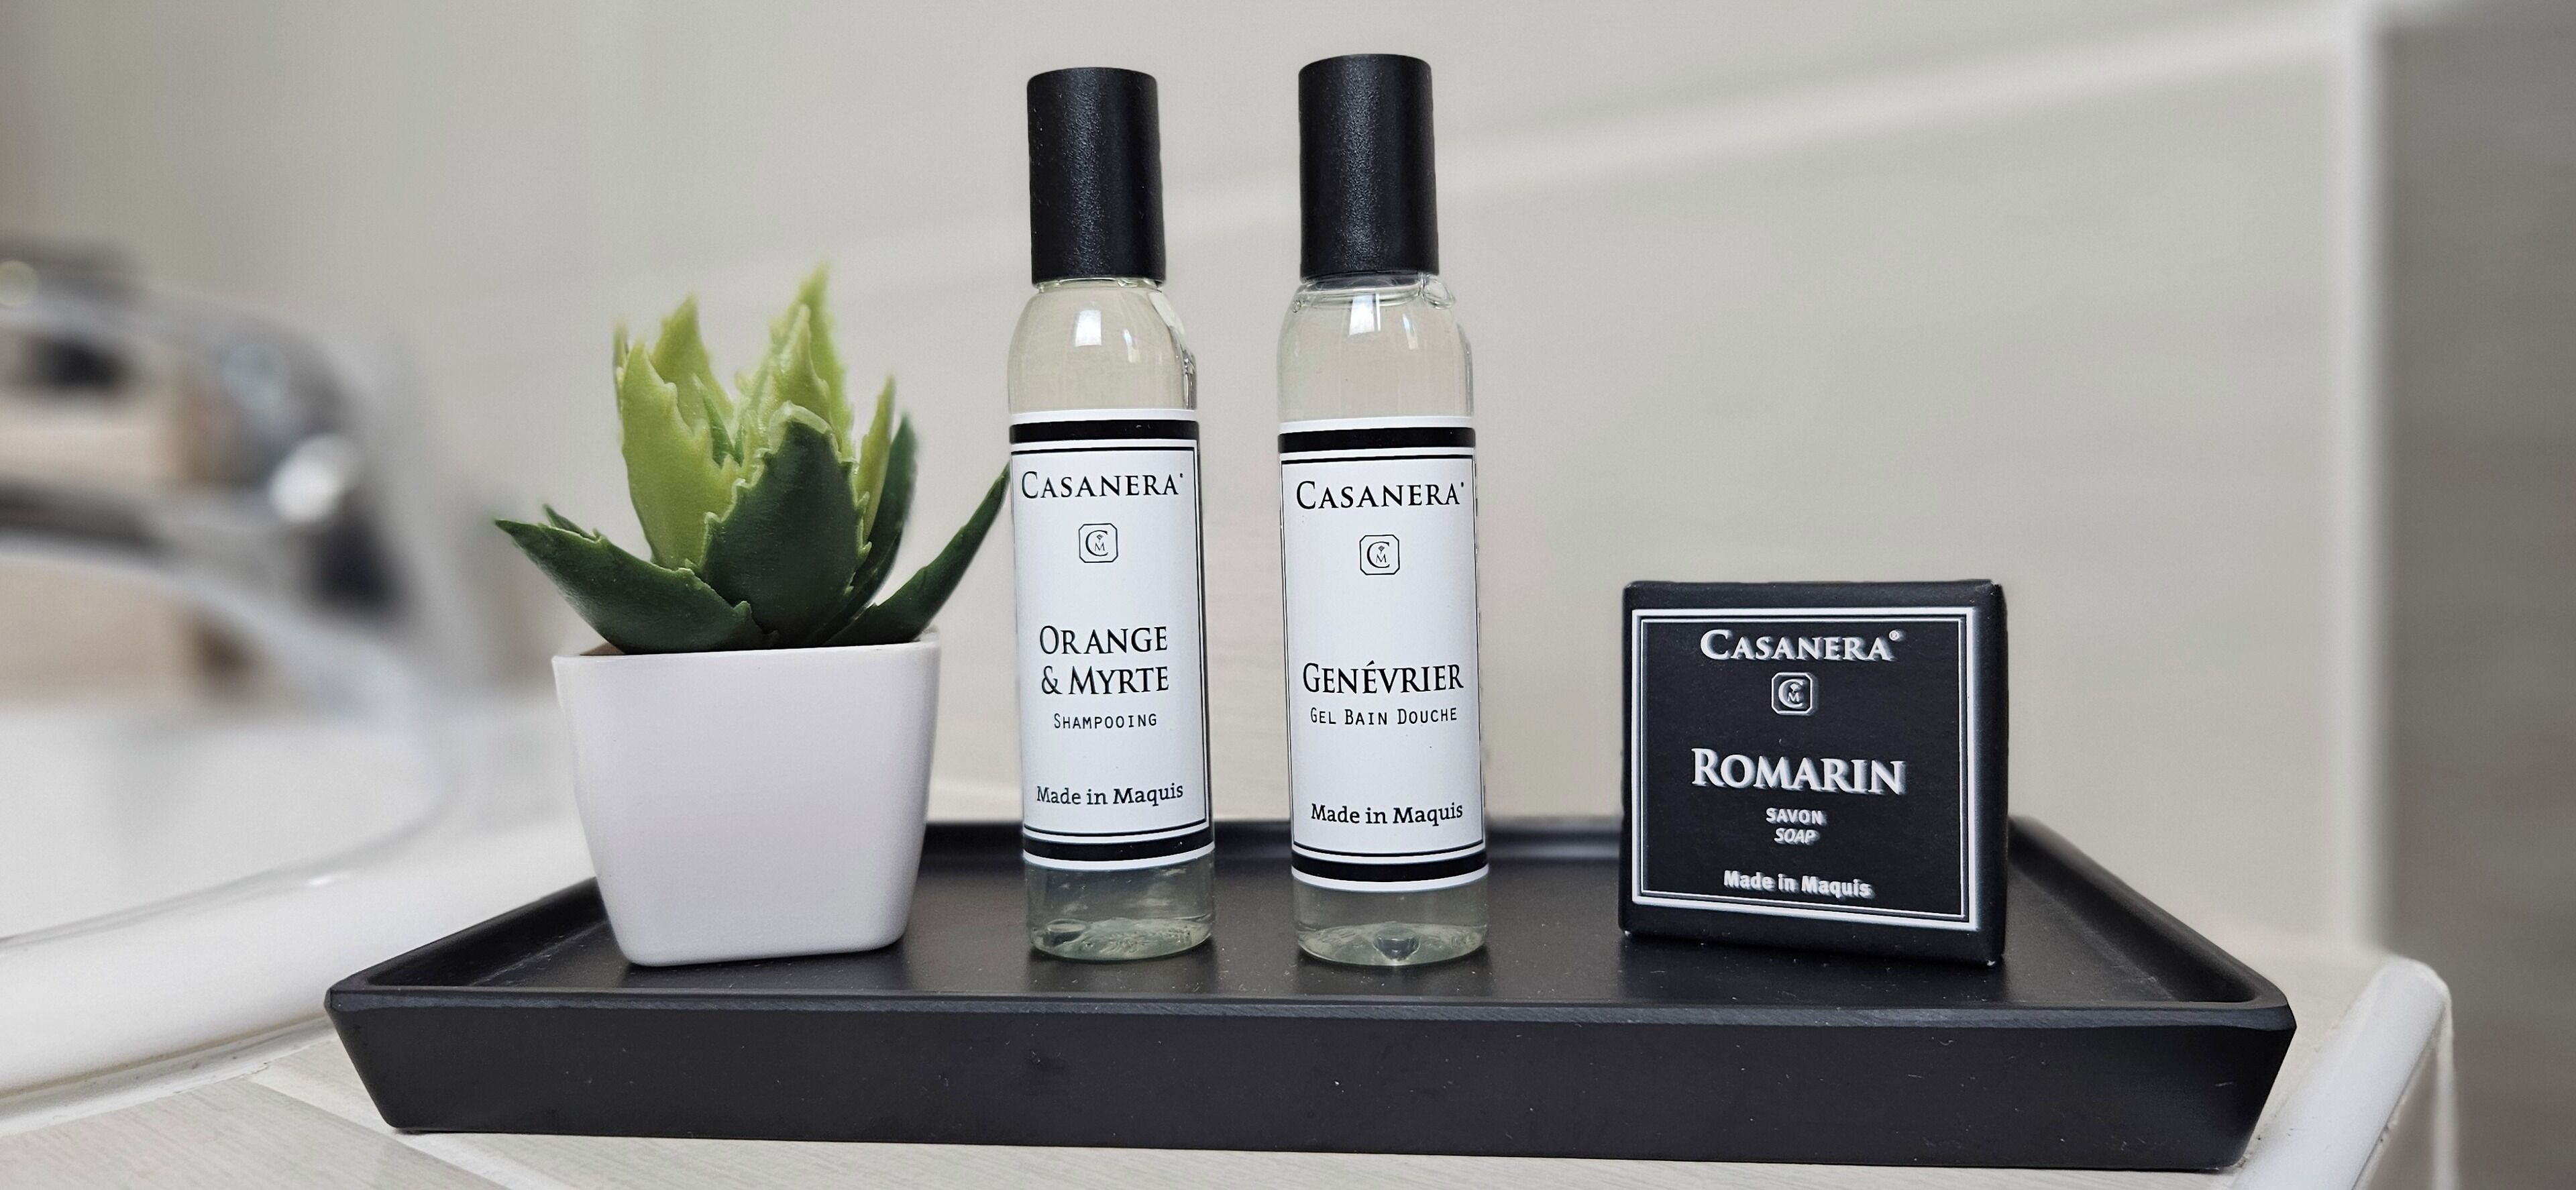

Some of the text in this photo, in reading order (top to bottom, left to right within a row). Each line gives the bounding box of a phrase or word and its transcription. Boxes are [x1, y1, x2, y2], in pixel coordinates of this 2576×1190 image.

[1039, 625, 1168, 655] ORANGE
[1041, 665, 1169, 695] & MYRTE
[1303, 659, 1464, 694] GENÉVRIER
[1054, 712, 1158, 729] SHAMPOOING
[1310, 707, 1457, 726] GEL BAIN DOUCHE
[1691, 747, 1907, 795] ROMARIN
[1036, 782, 1184, 807] Made in Maquis
[1311, 802, 1464, 827] Made in Maquis
[1766, 807, 1826, 825] SAVON
[1774, 827, 1819, 845] SOAP
[1723, 870, 1875, 900] Made in Maquis
